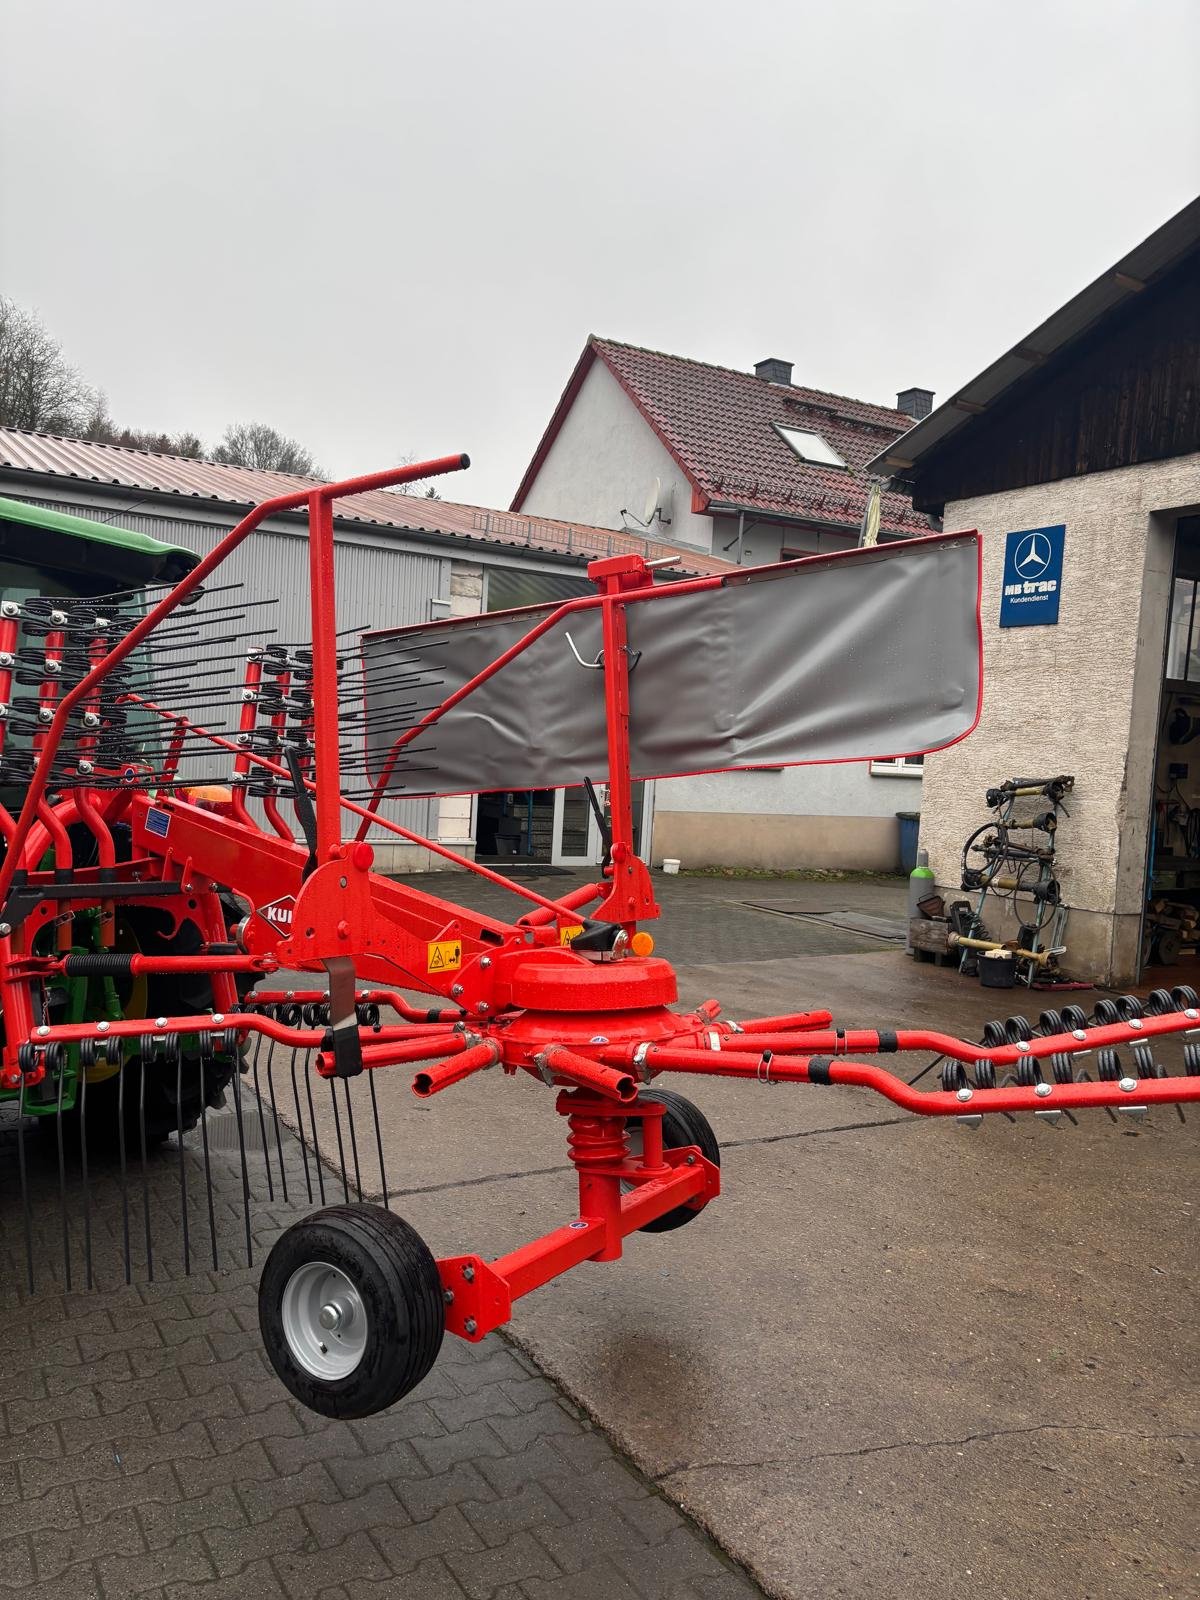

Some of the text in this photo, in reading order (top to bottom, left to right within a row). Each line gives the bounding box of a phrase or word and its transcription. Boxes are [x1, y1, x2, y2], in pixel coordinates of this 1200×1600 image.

[1005, 580, 1057, 596] MB trac
[1010, 594, 1049, 604] Kundendienst
